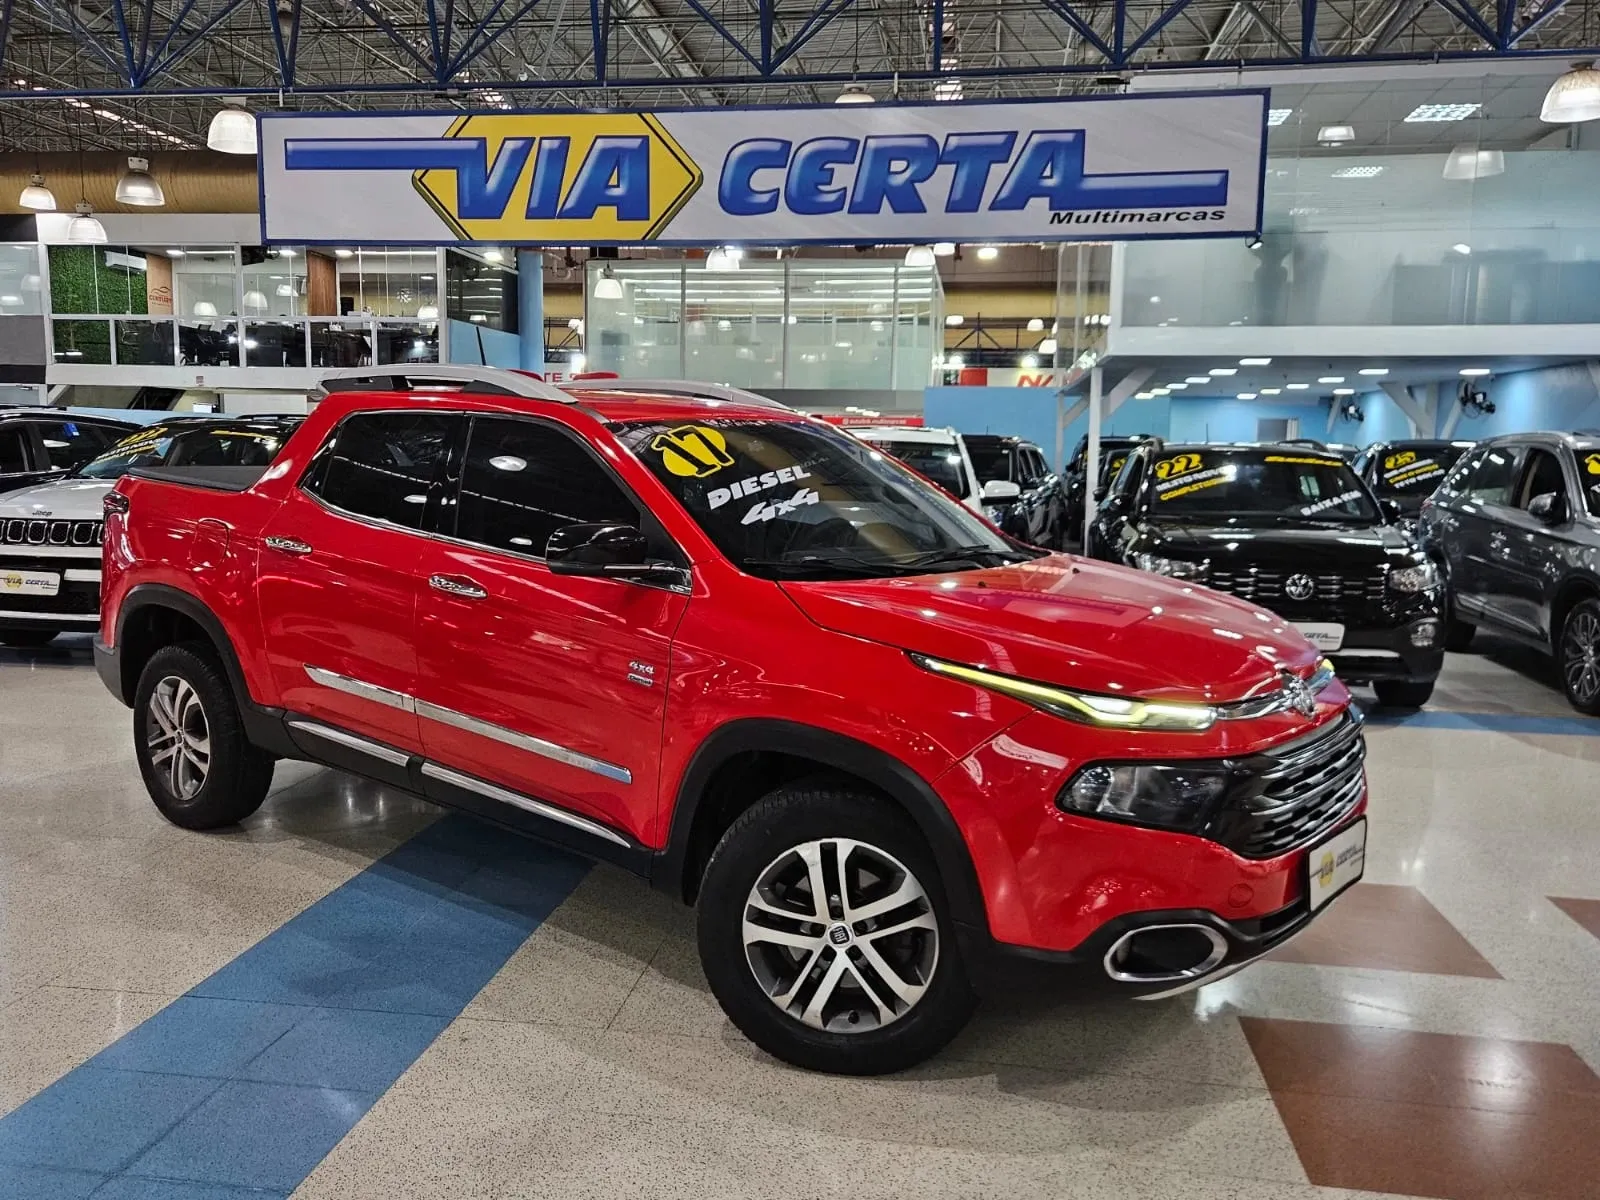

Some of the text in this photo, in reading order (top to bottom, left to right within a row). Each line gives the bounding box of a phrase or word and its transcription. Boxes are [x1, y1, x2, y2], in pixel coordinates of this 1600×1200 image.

[455, 129, 1087, 221] VIA CERTA
[1049, 208, 1227, 226] Multimarcas
[651, 424, 736, 478] 17
[1154, 453, 1203, 481] 22
[707, 465, 812, 510] DIESEL
[740, 488, 820, 526] 4x4
